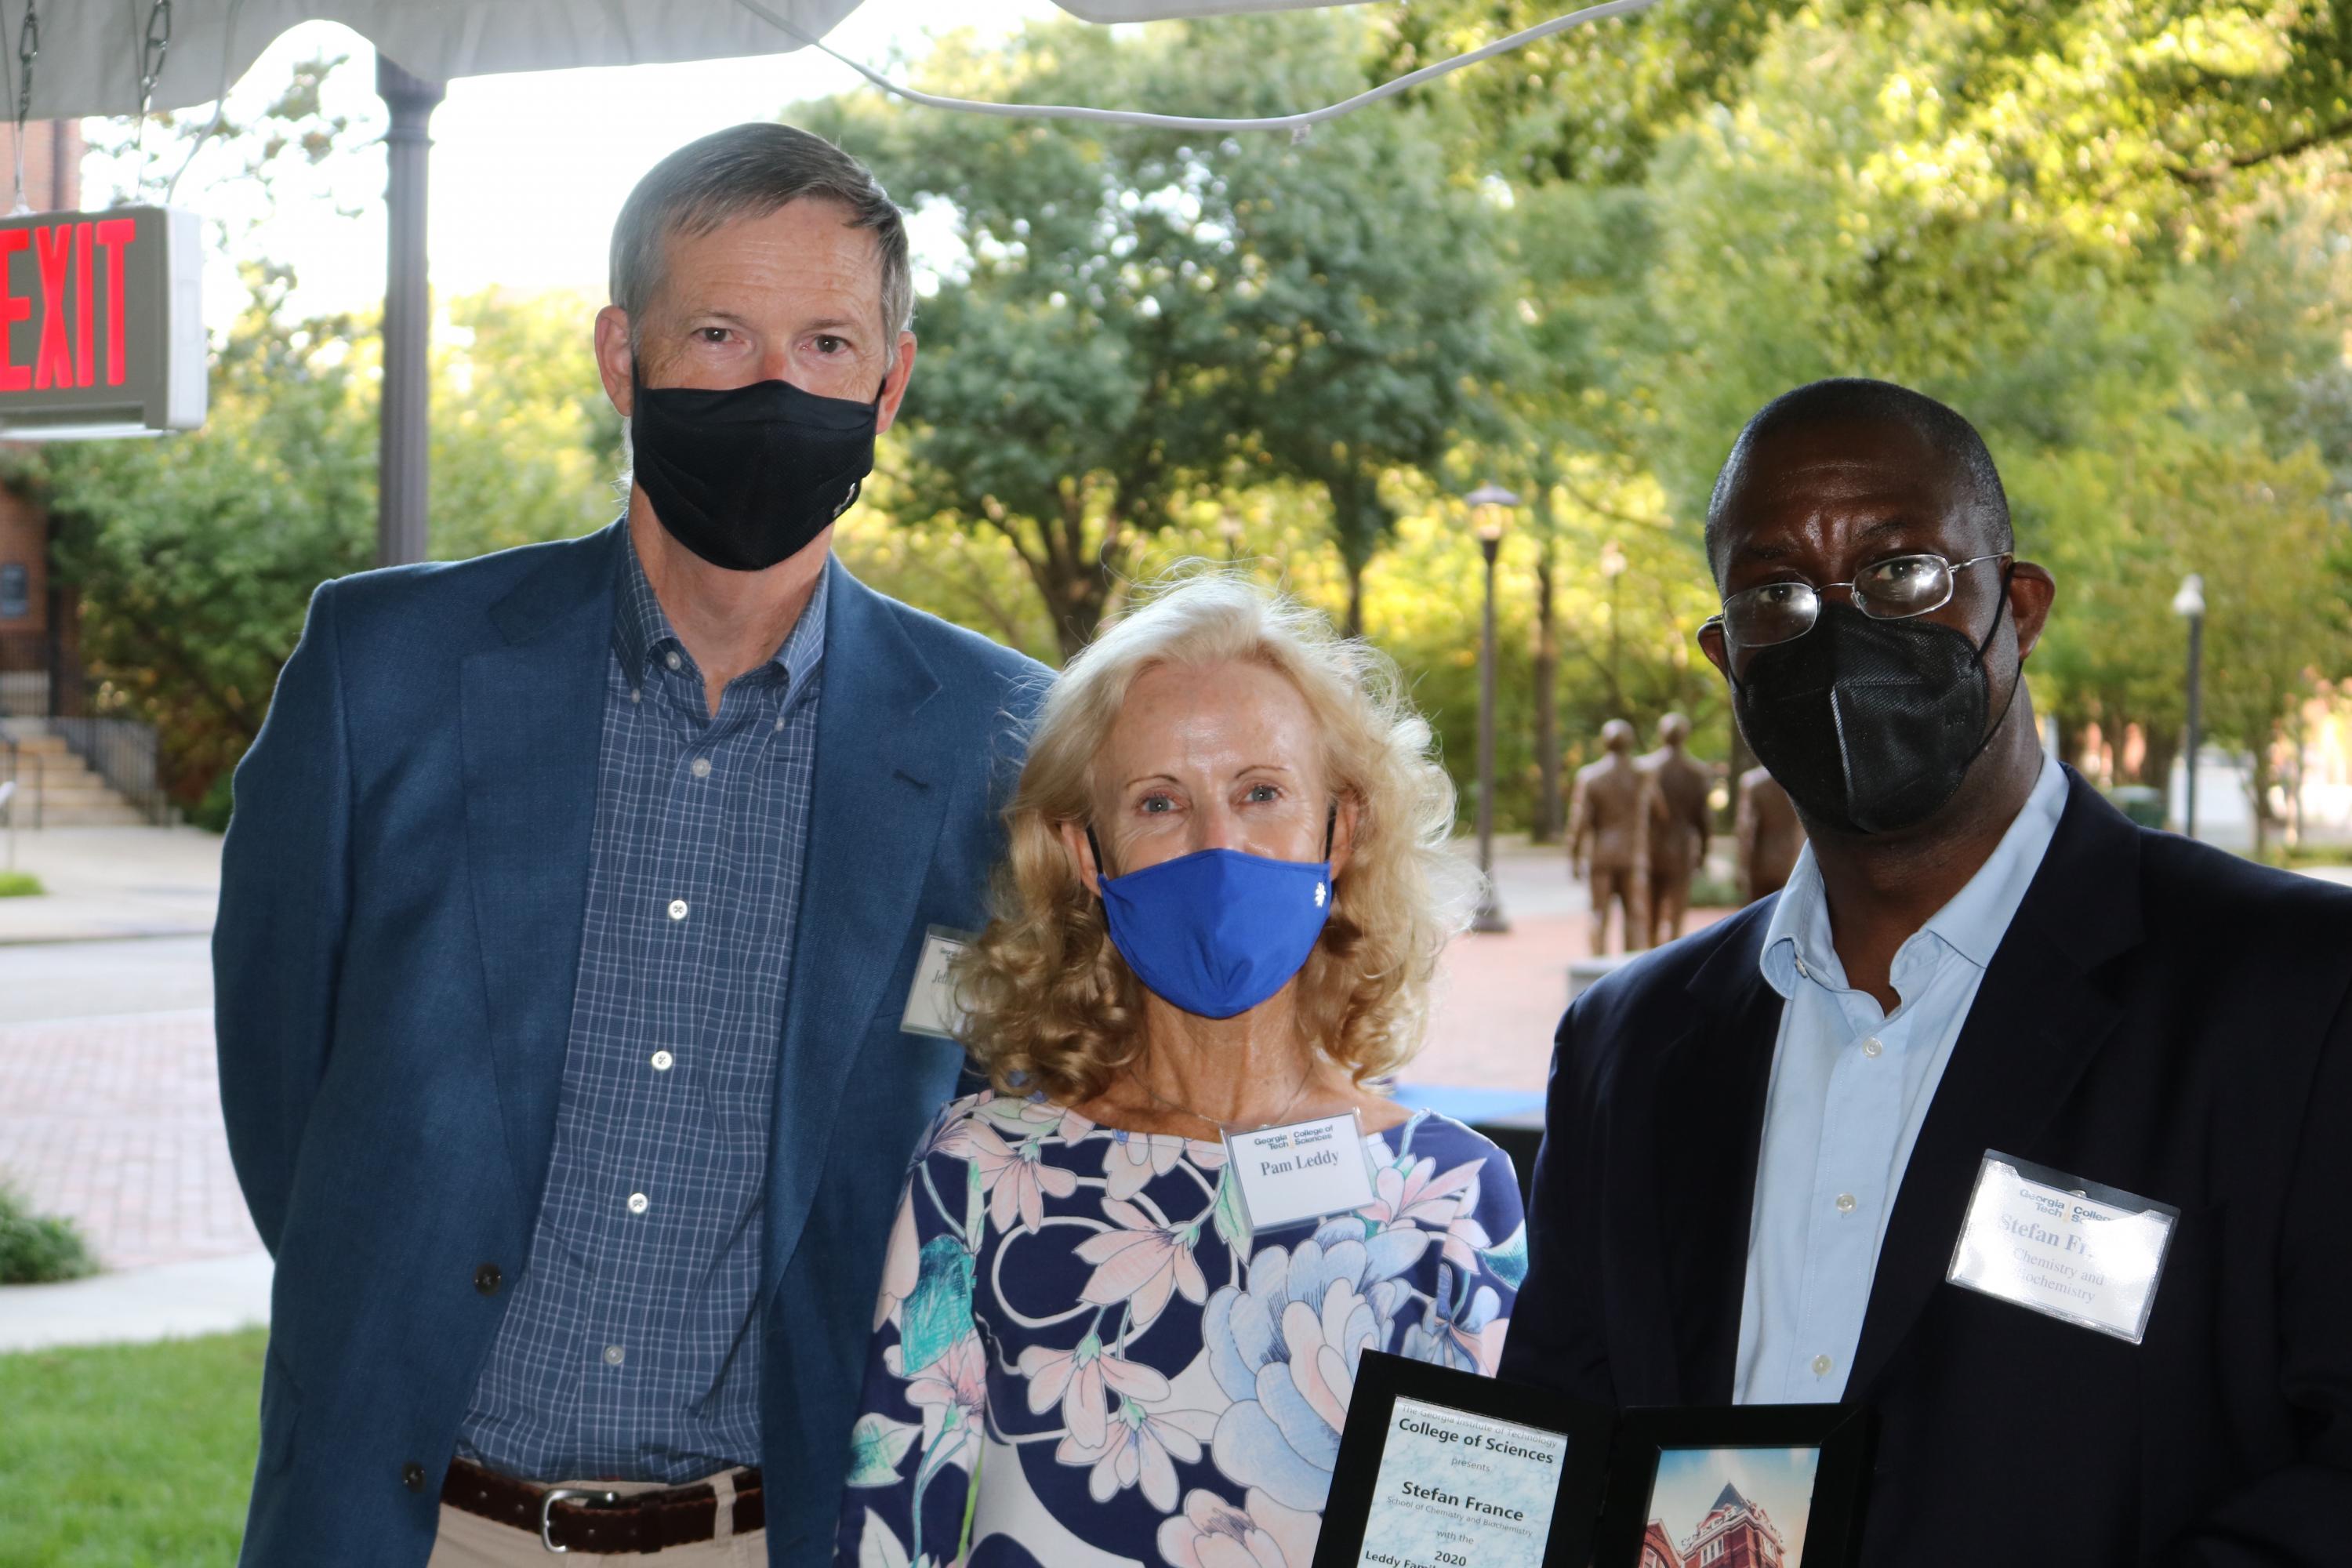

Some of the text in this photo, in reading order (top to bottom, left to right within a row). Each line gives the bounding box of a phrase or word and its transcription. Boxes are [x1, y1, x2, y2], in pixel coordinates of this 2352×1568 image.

[0, 218, 136, 391] EXIT
[1254, 1134, 1287, 1145] Georgia
[1294, 1124, 1334, 1139] College of
[1294, 1134, 1333, 1145] Sciences
[1268, 1141, 1289, 1150] Tech
[1261, 1150, 1339, 1176] Pam Leddy
[2019, 1188, 2065, 1210] Georgia
[2035, 1203, 2063, 1218] Tech
[1998, 1213, 2060, 1248] Stefan
[2013, 1248, 2104, 1287] Chemistry and
[1403, 1404, 1557, 1449] The Georgia Institute of Technology
[1399, 1417, 1555, 1465] College of Sciences
[1402, 1480, 1524, 1522] Stefan France
[1387, 1495, 1534, 1538] School of Chemistry and Biochemistry
[1436, 1530, 1475, 1545] with the
[1365, 1550, 1401, 1568] Leddy
[1434, 1551, 1467, 1567] 2020
